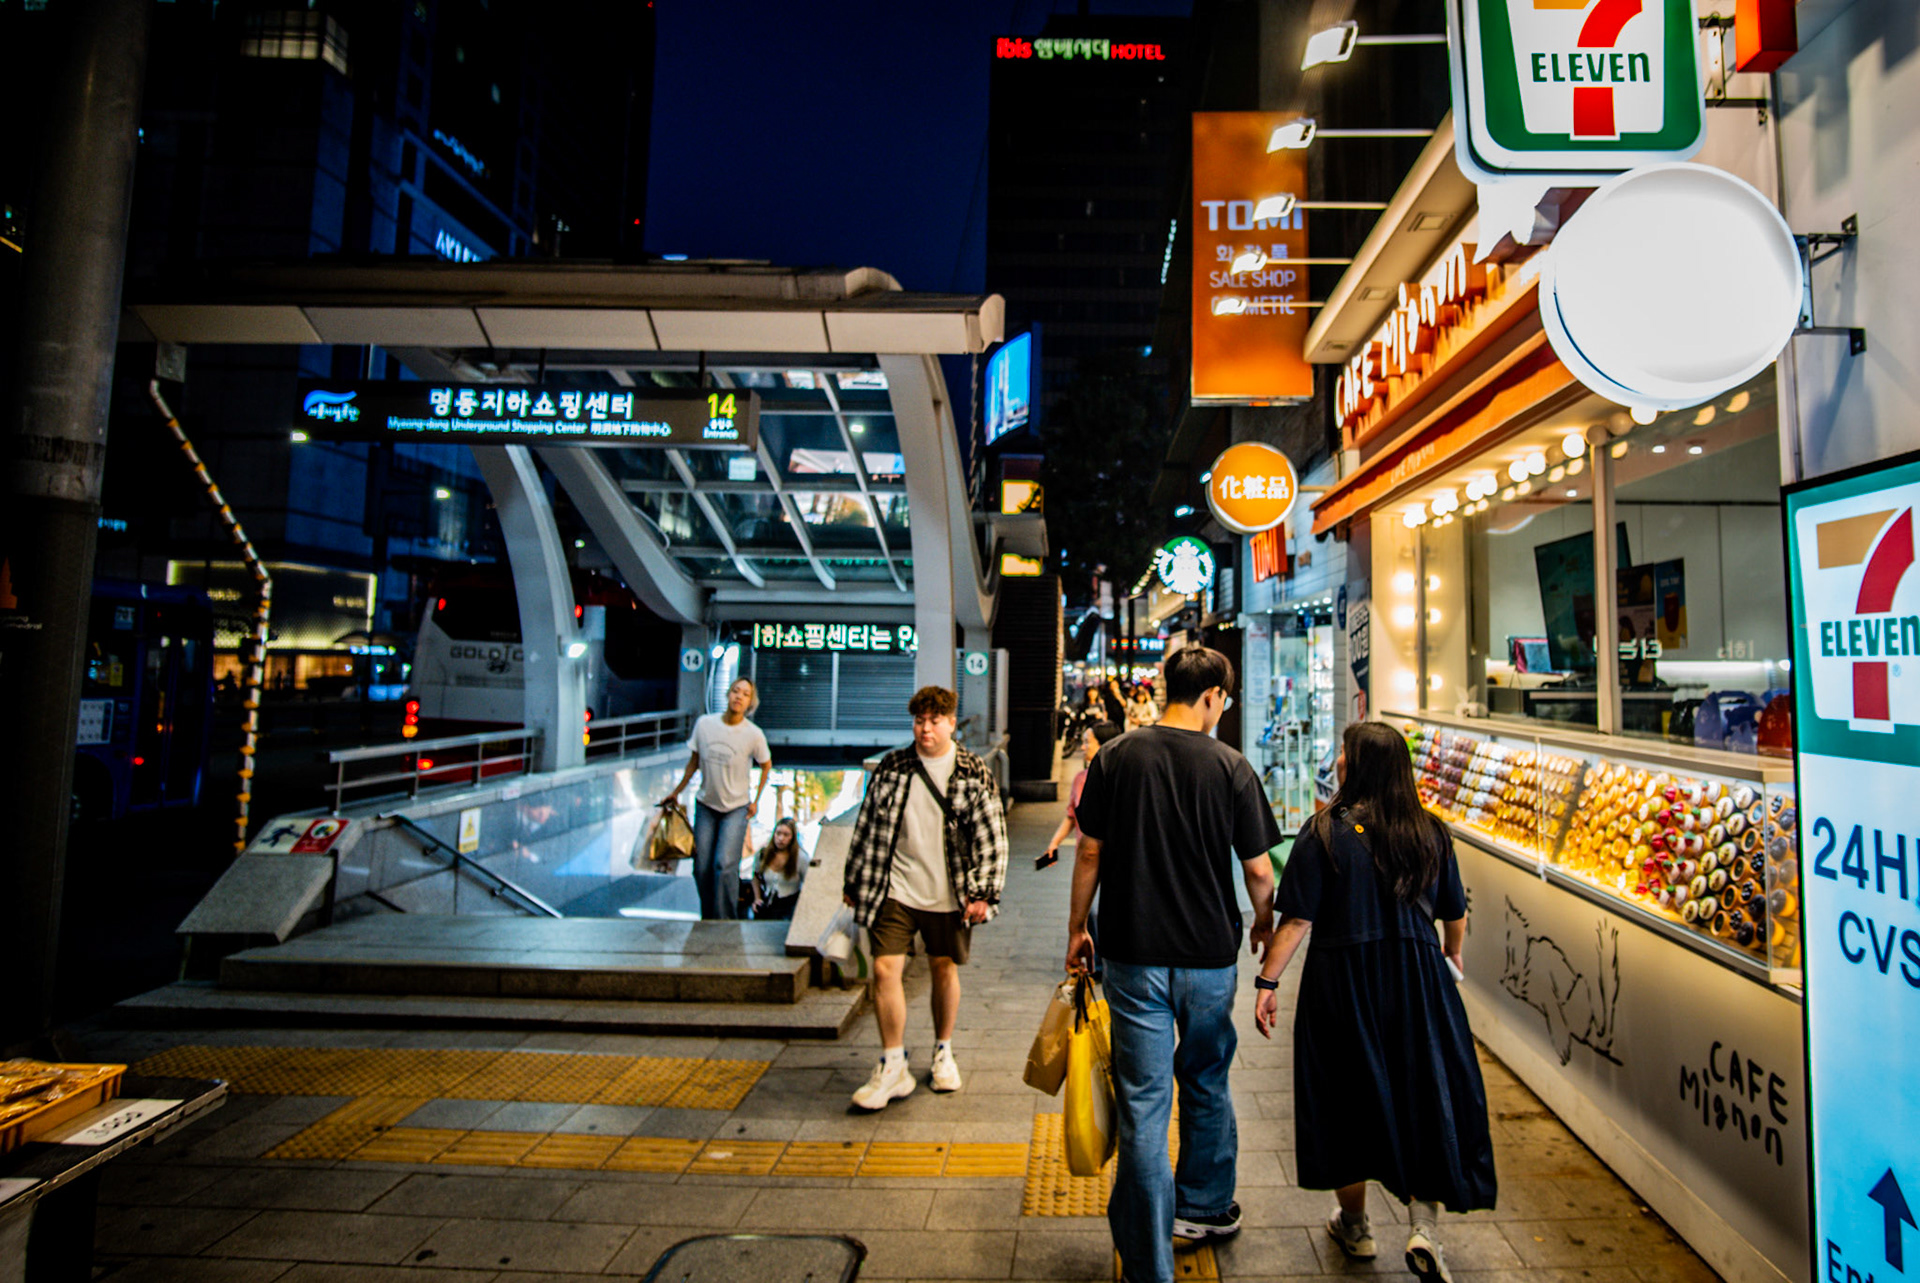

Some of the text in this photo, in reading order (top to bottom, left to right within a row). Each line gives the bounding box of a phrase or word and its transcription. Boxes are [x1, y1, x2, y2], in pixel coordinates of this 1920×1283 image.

[1111, 43, 1166, 61] HOTEL
[1209, 270, 1296, 288] SALE SHOP
[429, 387, 635, 421] 명동지하쇼핑센터
[707, 393, 738, 419] 14
[387, 416, 450, 432] Myeong-dong
[451, 418, 511, 434] Underground
[511, 420, 554, 435] Shopping
[555, 420, 588, 434] Center
[1219, 475, 1290, 501] 化粧品
[1812, 816, 1920, 907] 24H
[1710, 1040, 1788, 1125] CAFE
